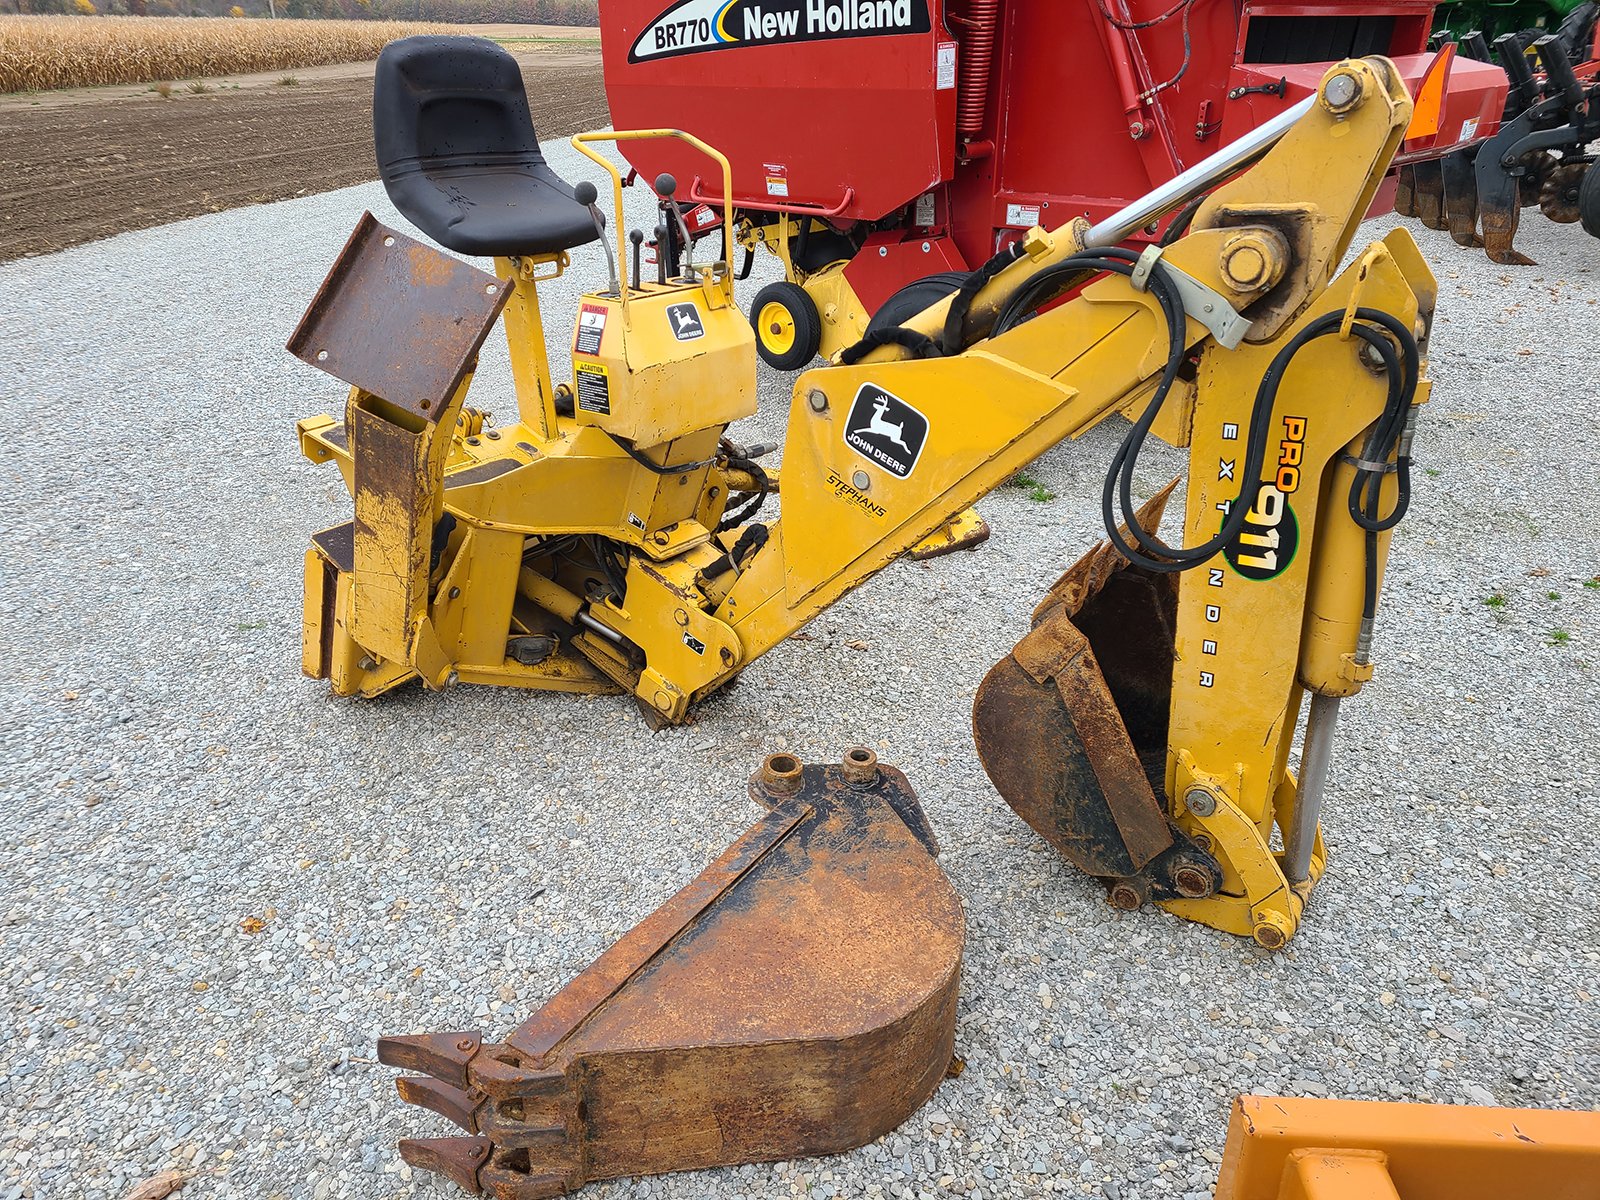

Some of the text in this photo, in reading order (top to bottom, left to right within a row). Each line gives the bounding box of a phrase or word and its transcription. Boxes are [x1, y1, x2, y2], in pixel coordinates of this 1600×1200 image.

[654, 17, 710, 50] BR770
[743, 0, 911, 39] New Holland
[588, 304, 606, 313] DANGER
[583, 363, 604, 373] CAUTION
[847, 433, 907, 474] JOHN DEERE
[1276, 416, 1307, 493] PRO
[826, 474, 887, 517] STEPHANS
[1237, 485, 1285, 570] 911
[1199, 422, 1239, 688] EXTNDER
